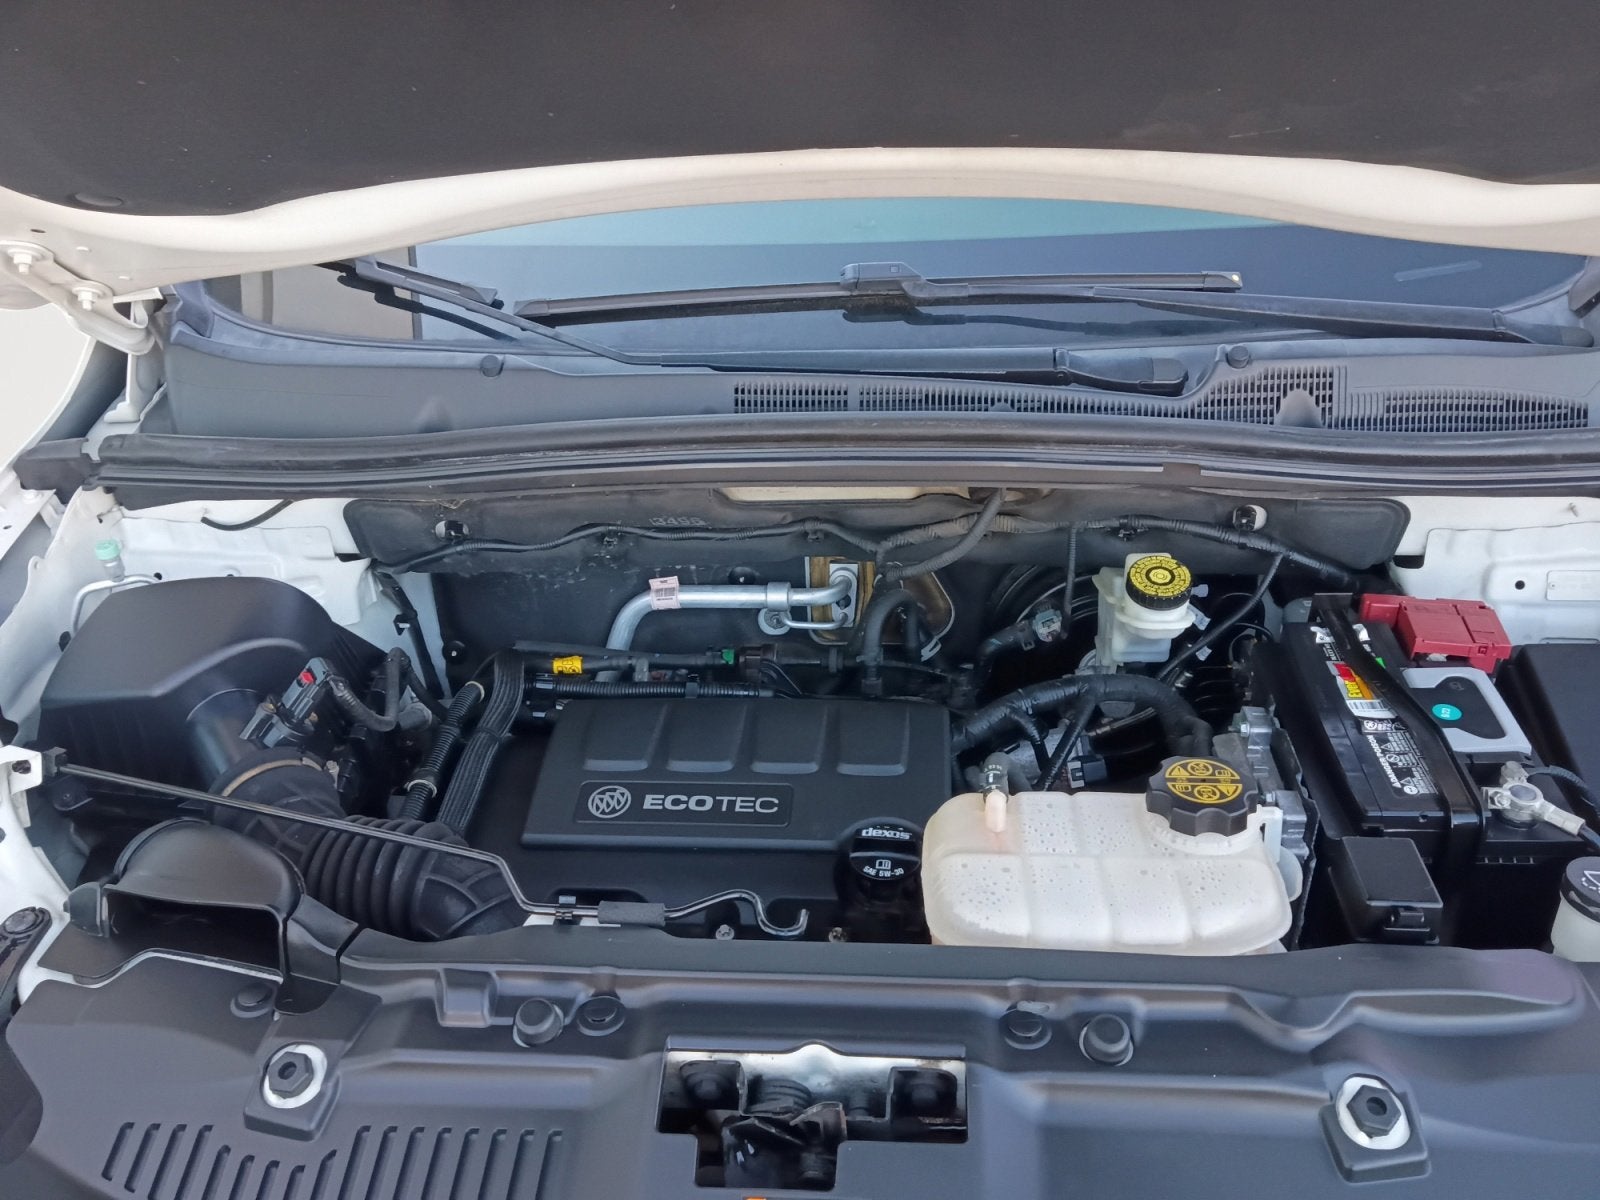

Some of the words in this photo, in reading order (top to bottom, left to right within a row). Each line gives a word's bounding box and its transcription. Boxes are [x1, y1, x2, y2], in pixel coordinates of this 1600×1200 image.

[642, 794, 779, 813] ECOTEC
[861, 827, 911, 840] dexos
[863, 865, 878, 876] SAE
[878, 867, 905, 877] 5W-30
